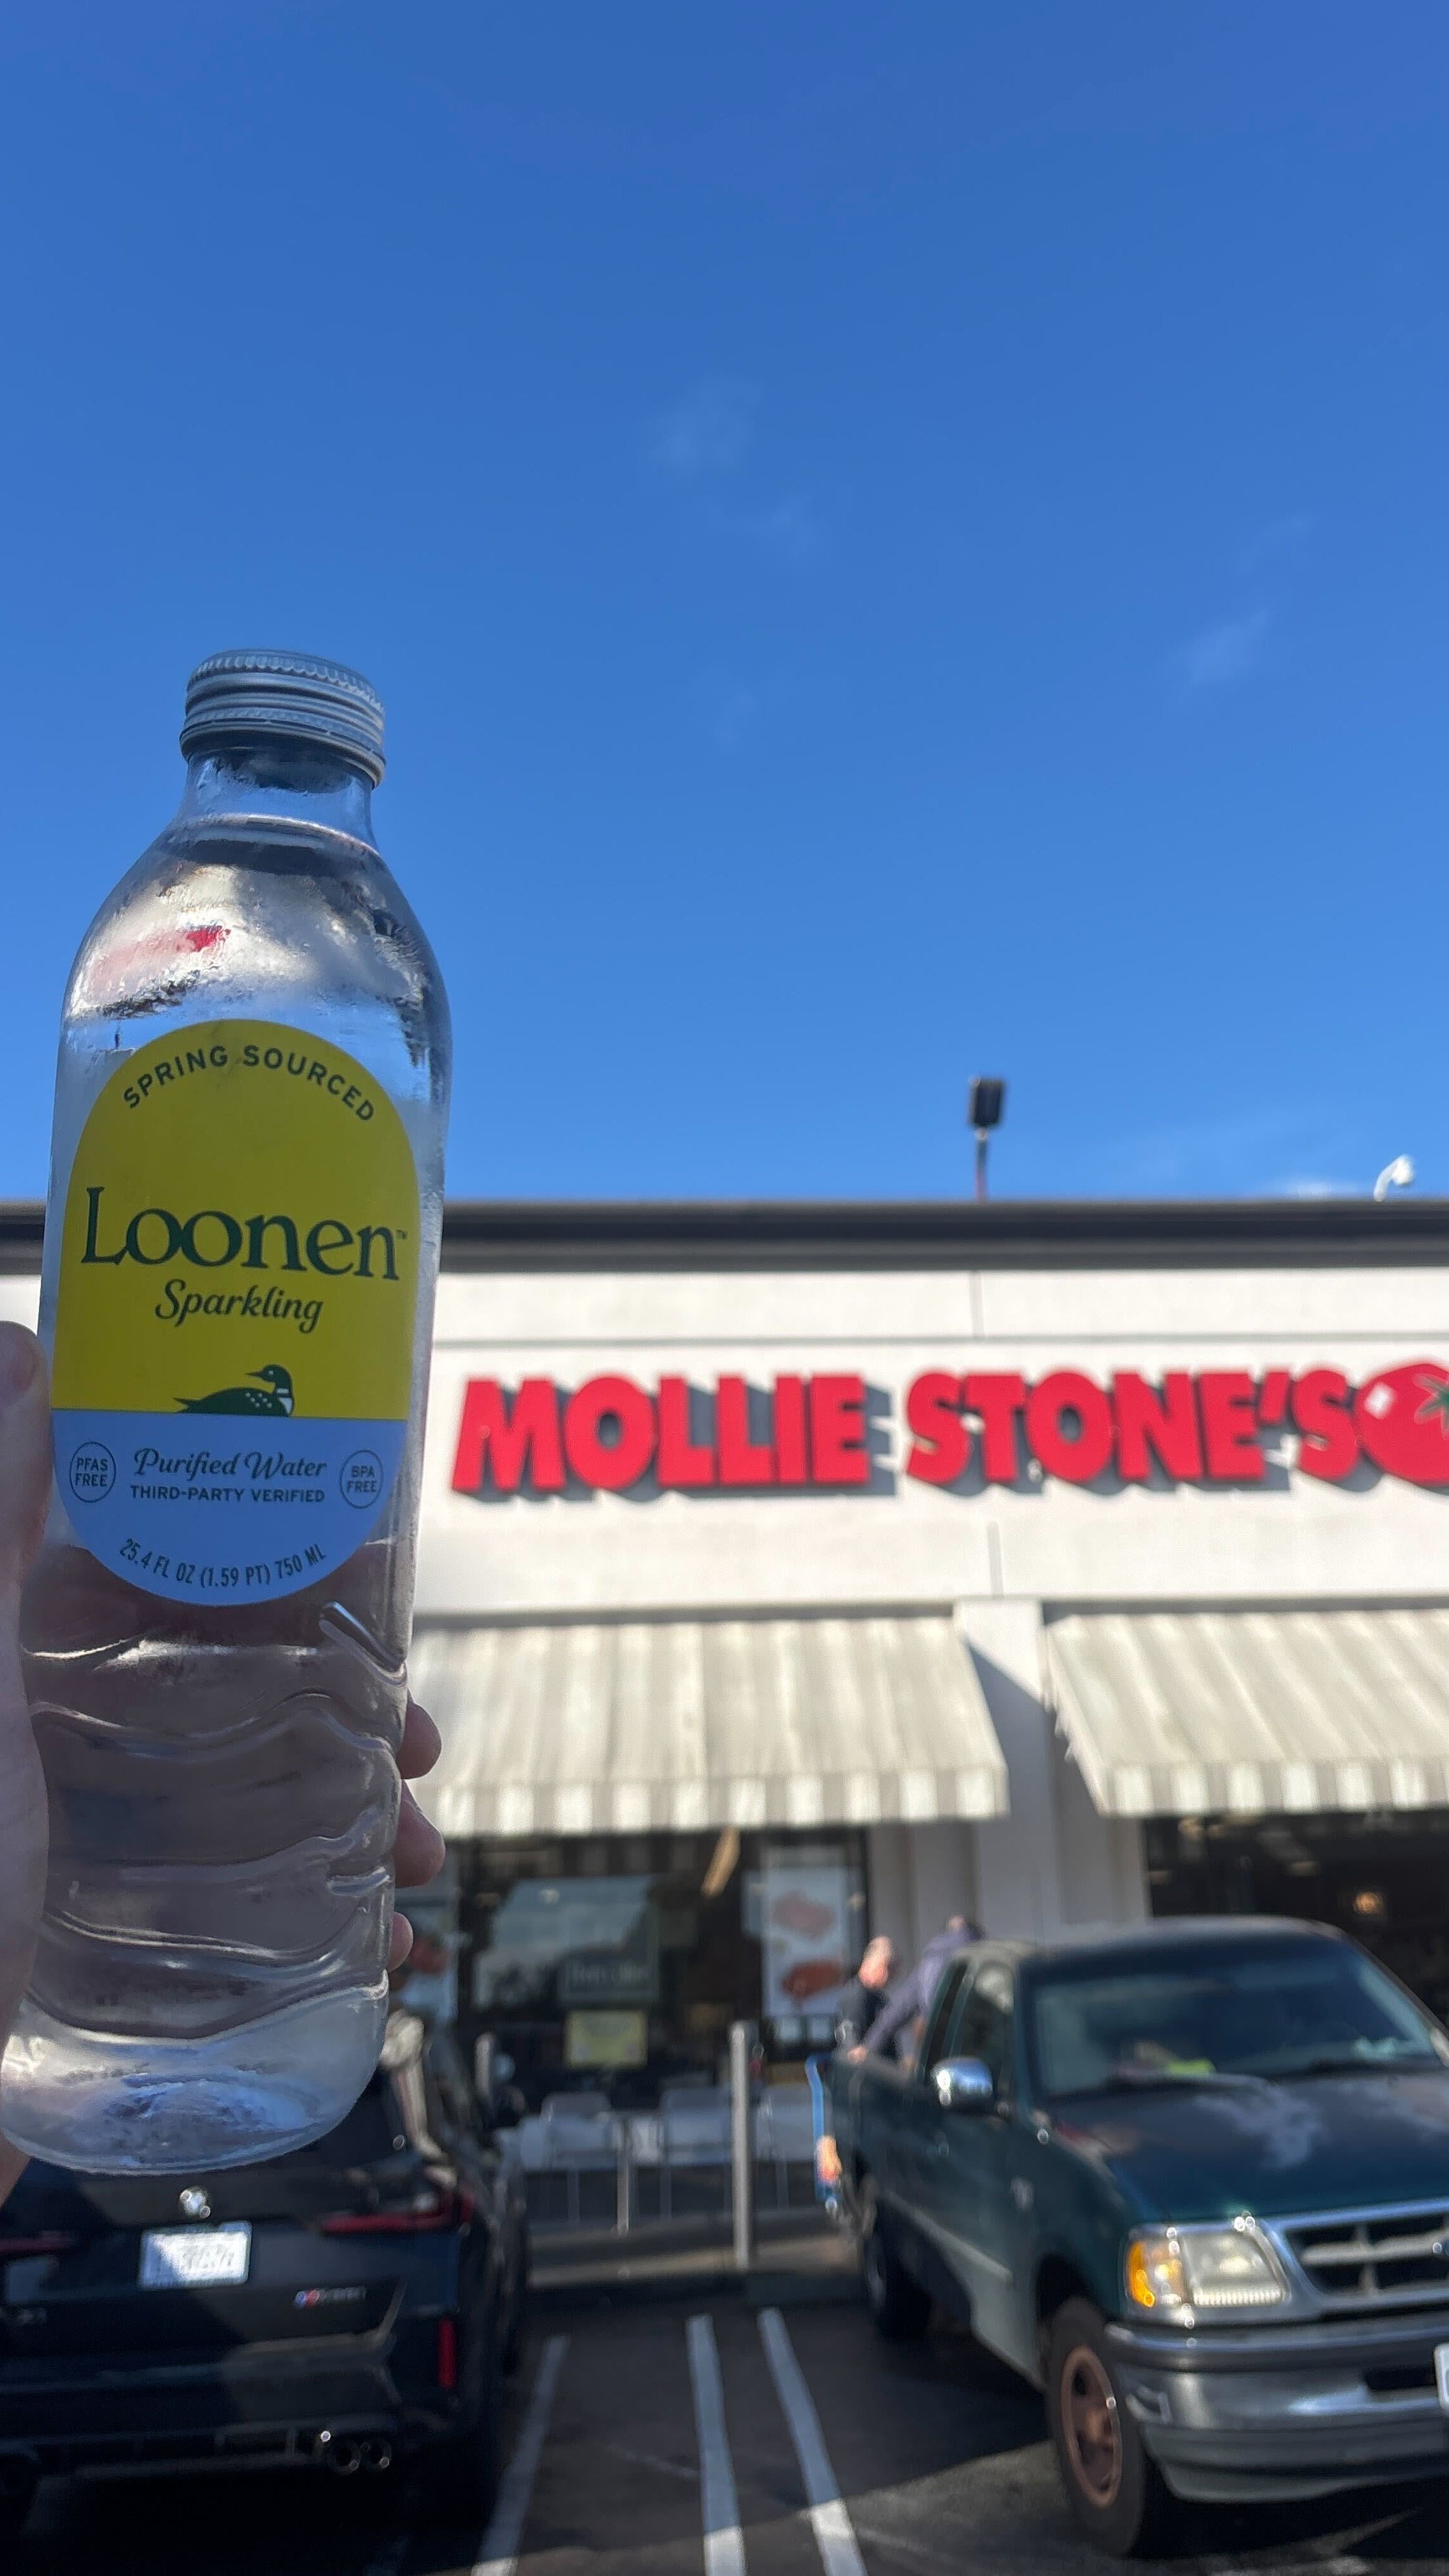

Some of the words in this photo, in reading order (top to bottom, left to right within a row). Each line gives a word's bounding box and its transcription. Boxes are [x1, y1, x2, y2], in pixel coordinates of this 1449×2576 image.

[123, 1045, 229, 1108] SPRING
[243, 1045, 374, 1121] SOURCED
[155, 1278, 323, 1334] Sparkling
[451, 1376, 870, 1491] MOLLIE
[906, 1369, 1361, 1483] STONE'S
[76, 1457, 108, 1471] PFAS
[134, 1448, 240, 1481] Purified
[243, 1451, 327, 1479] Water
[352, 1466, 374, 1477] BPA
[75, 1473, 107, 1487] FREE
[347, 1480, 377, 1492] FREE
[130, 1485, 243, 1503] THIRD-PARTY
[250, 1488, 325, 1503] VERIFIED
[119, 1538, 153, 1569] 25.4
[153, 1555, 171, 1578] FL
[176, 1563, 196, 1584] OZ
[201, 1567, 238, 1588] (1.59
[245, 1563, 270, 1585] PT)
[275, 1554, 303, 1579] 750
[305, 1543, 326, 1565] ML
